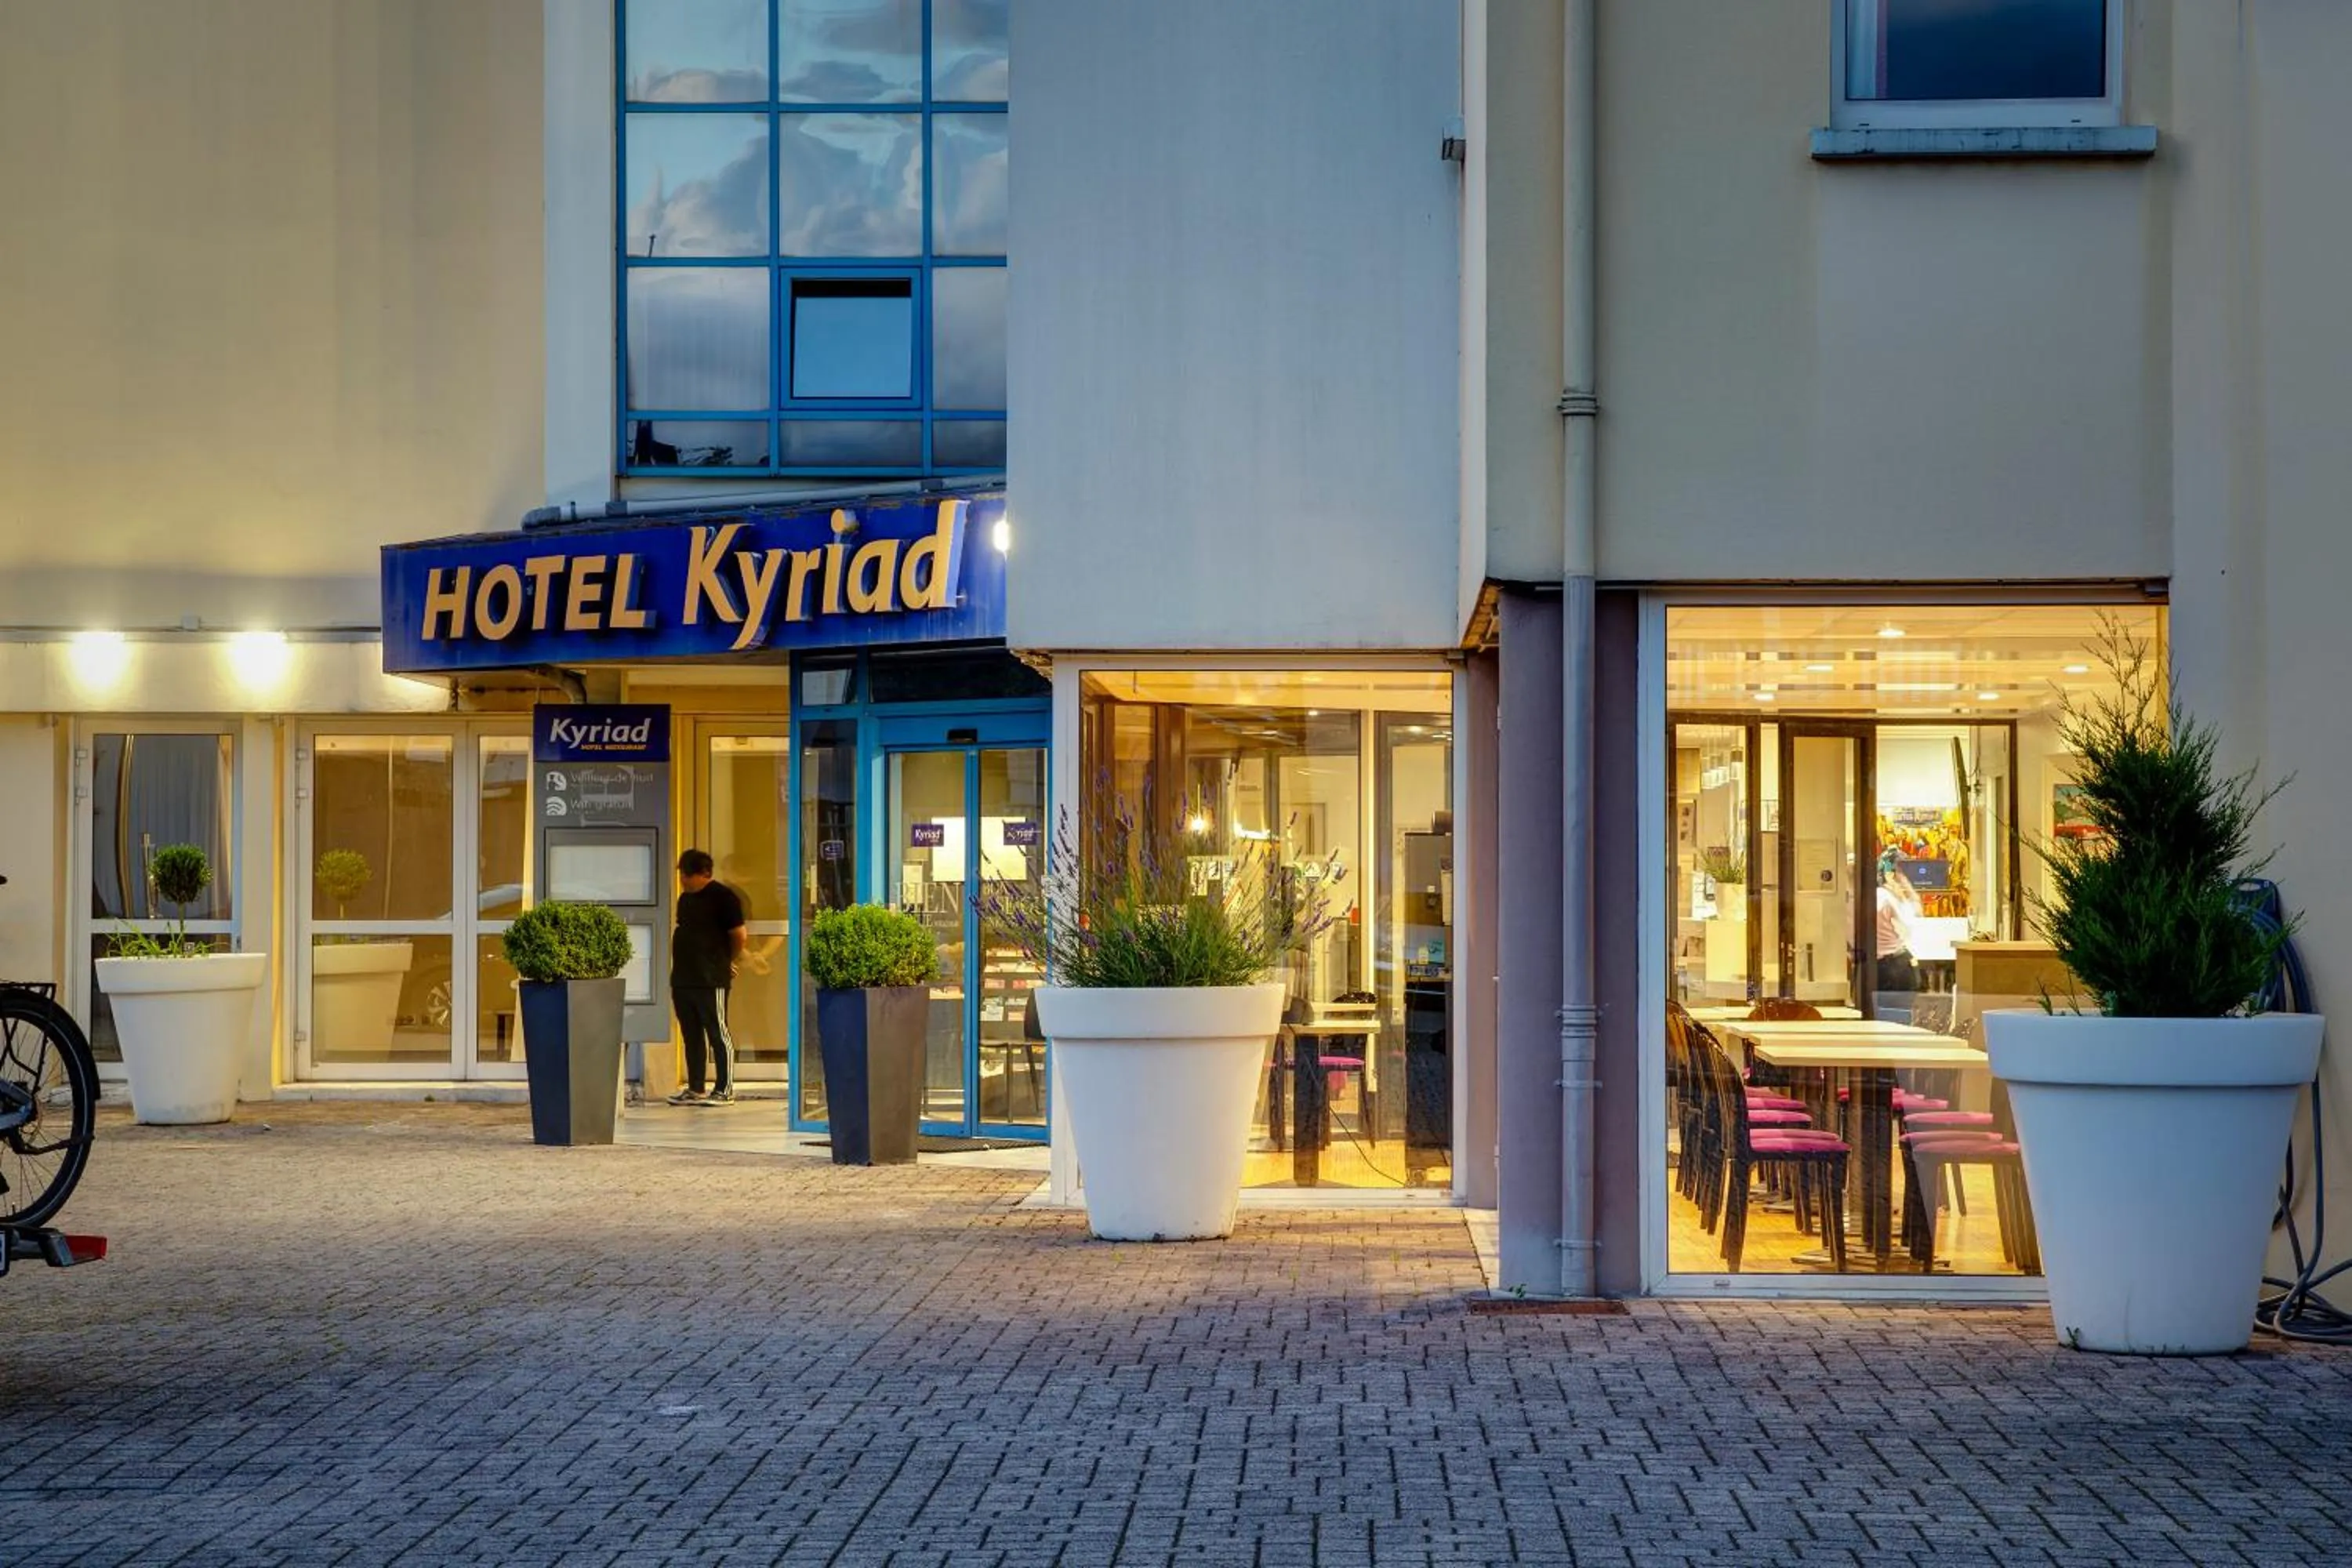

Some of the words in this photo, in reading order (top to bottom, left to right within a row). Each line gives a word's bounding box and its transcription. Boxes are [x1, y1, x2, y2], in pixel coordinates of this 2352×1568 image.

[422, 553, 651, 641] HOTEL
[683, 500, 969, 650] Kyriad
[550, 717, 652, 749] Kyriad
